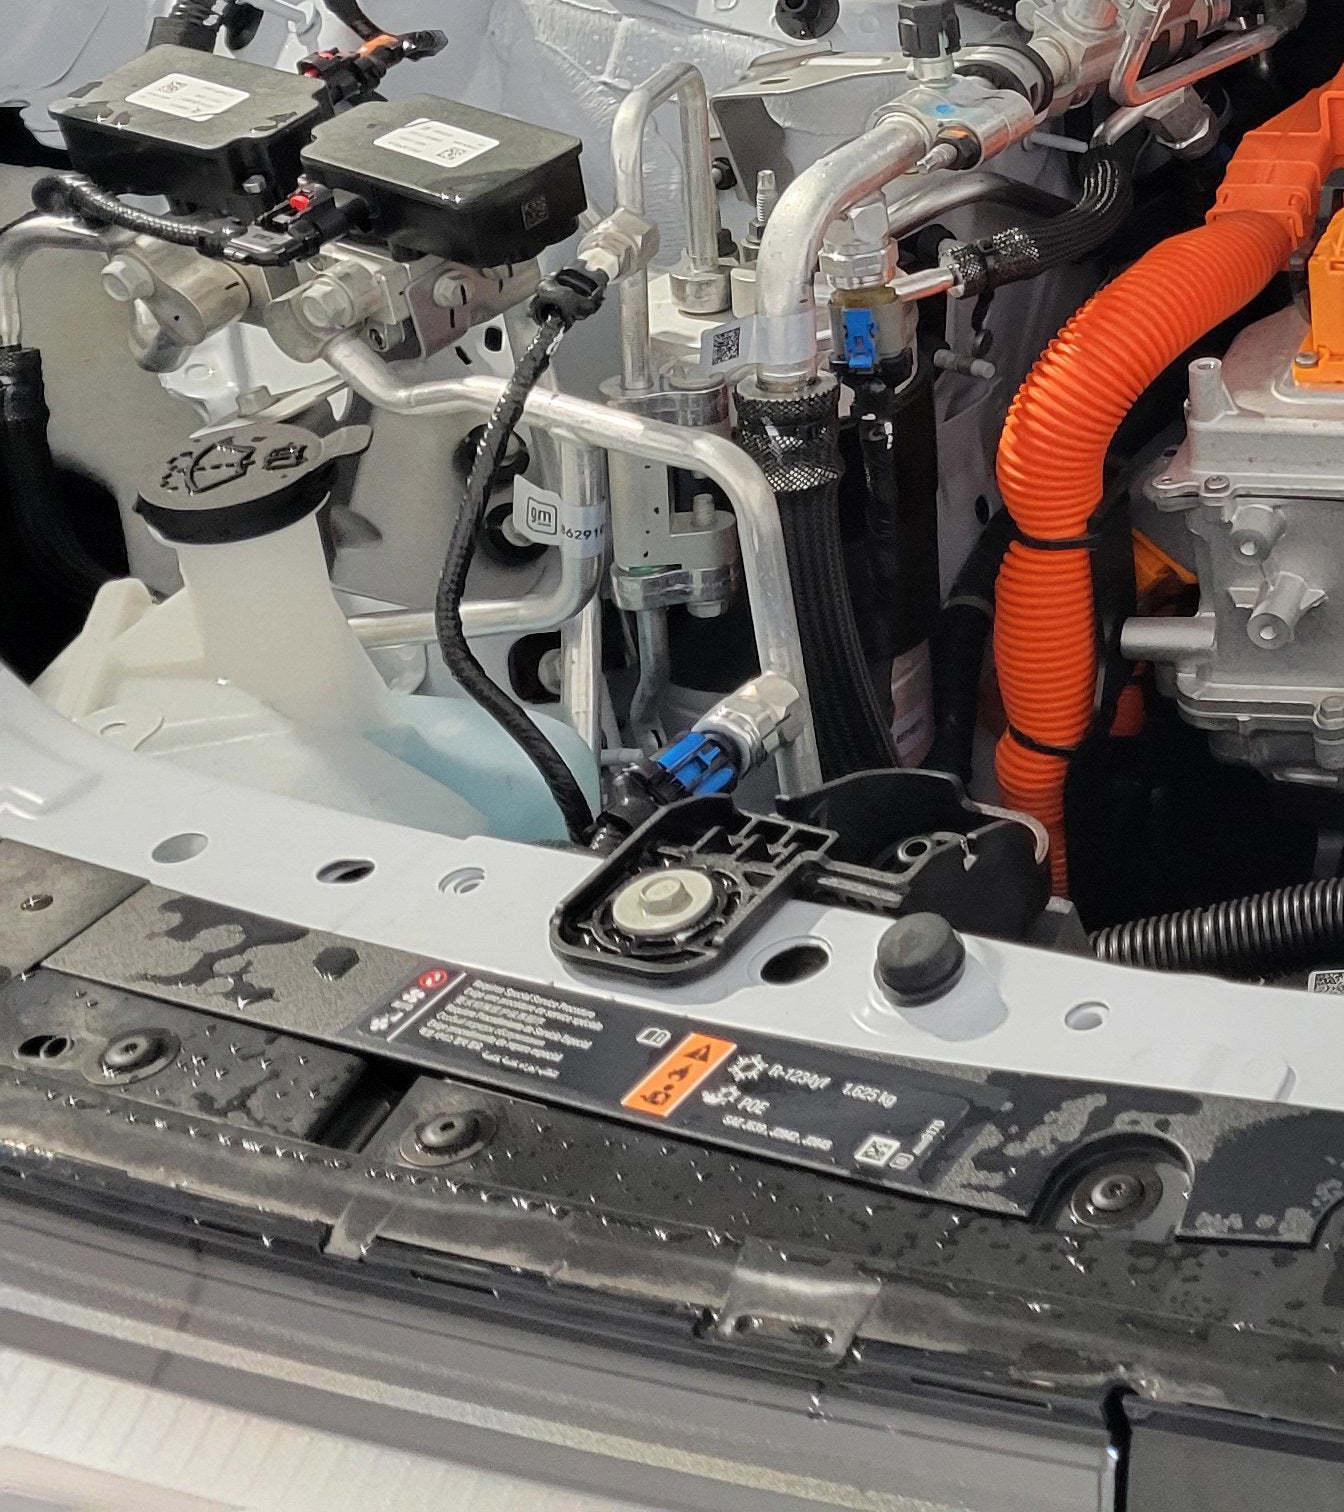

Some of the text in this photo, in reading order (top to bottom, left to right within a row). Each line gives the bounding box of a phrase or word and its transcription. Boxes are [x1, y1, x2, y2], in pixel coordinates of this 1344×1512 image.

[531, 506, 552, 524] gm
[767, 1063, 832, 1090] R-1234yf
[737, 1095, 771, 1116] POE
[842, 1082, 898, 1109] 1.625 kg
